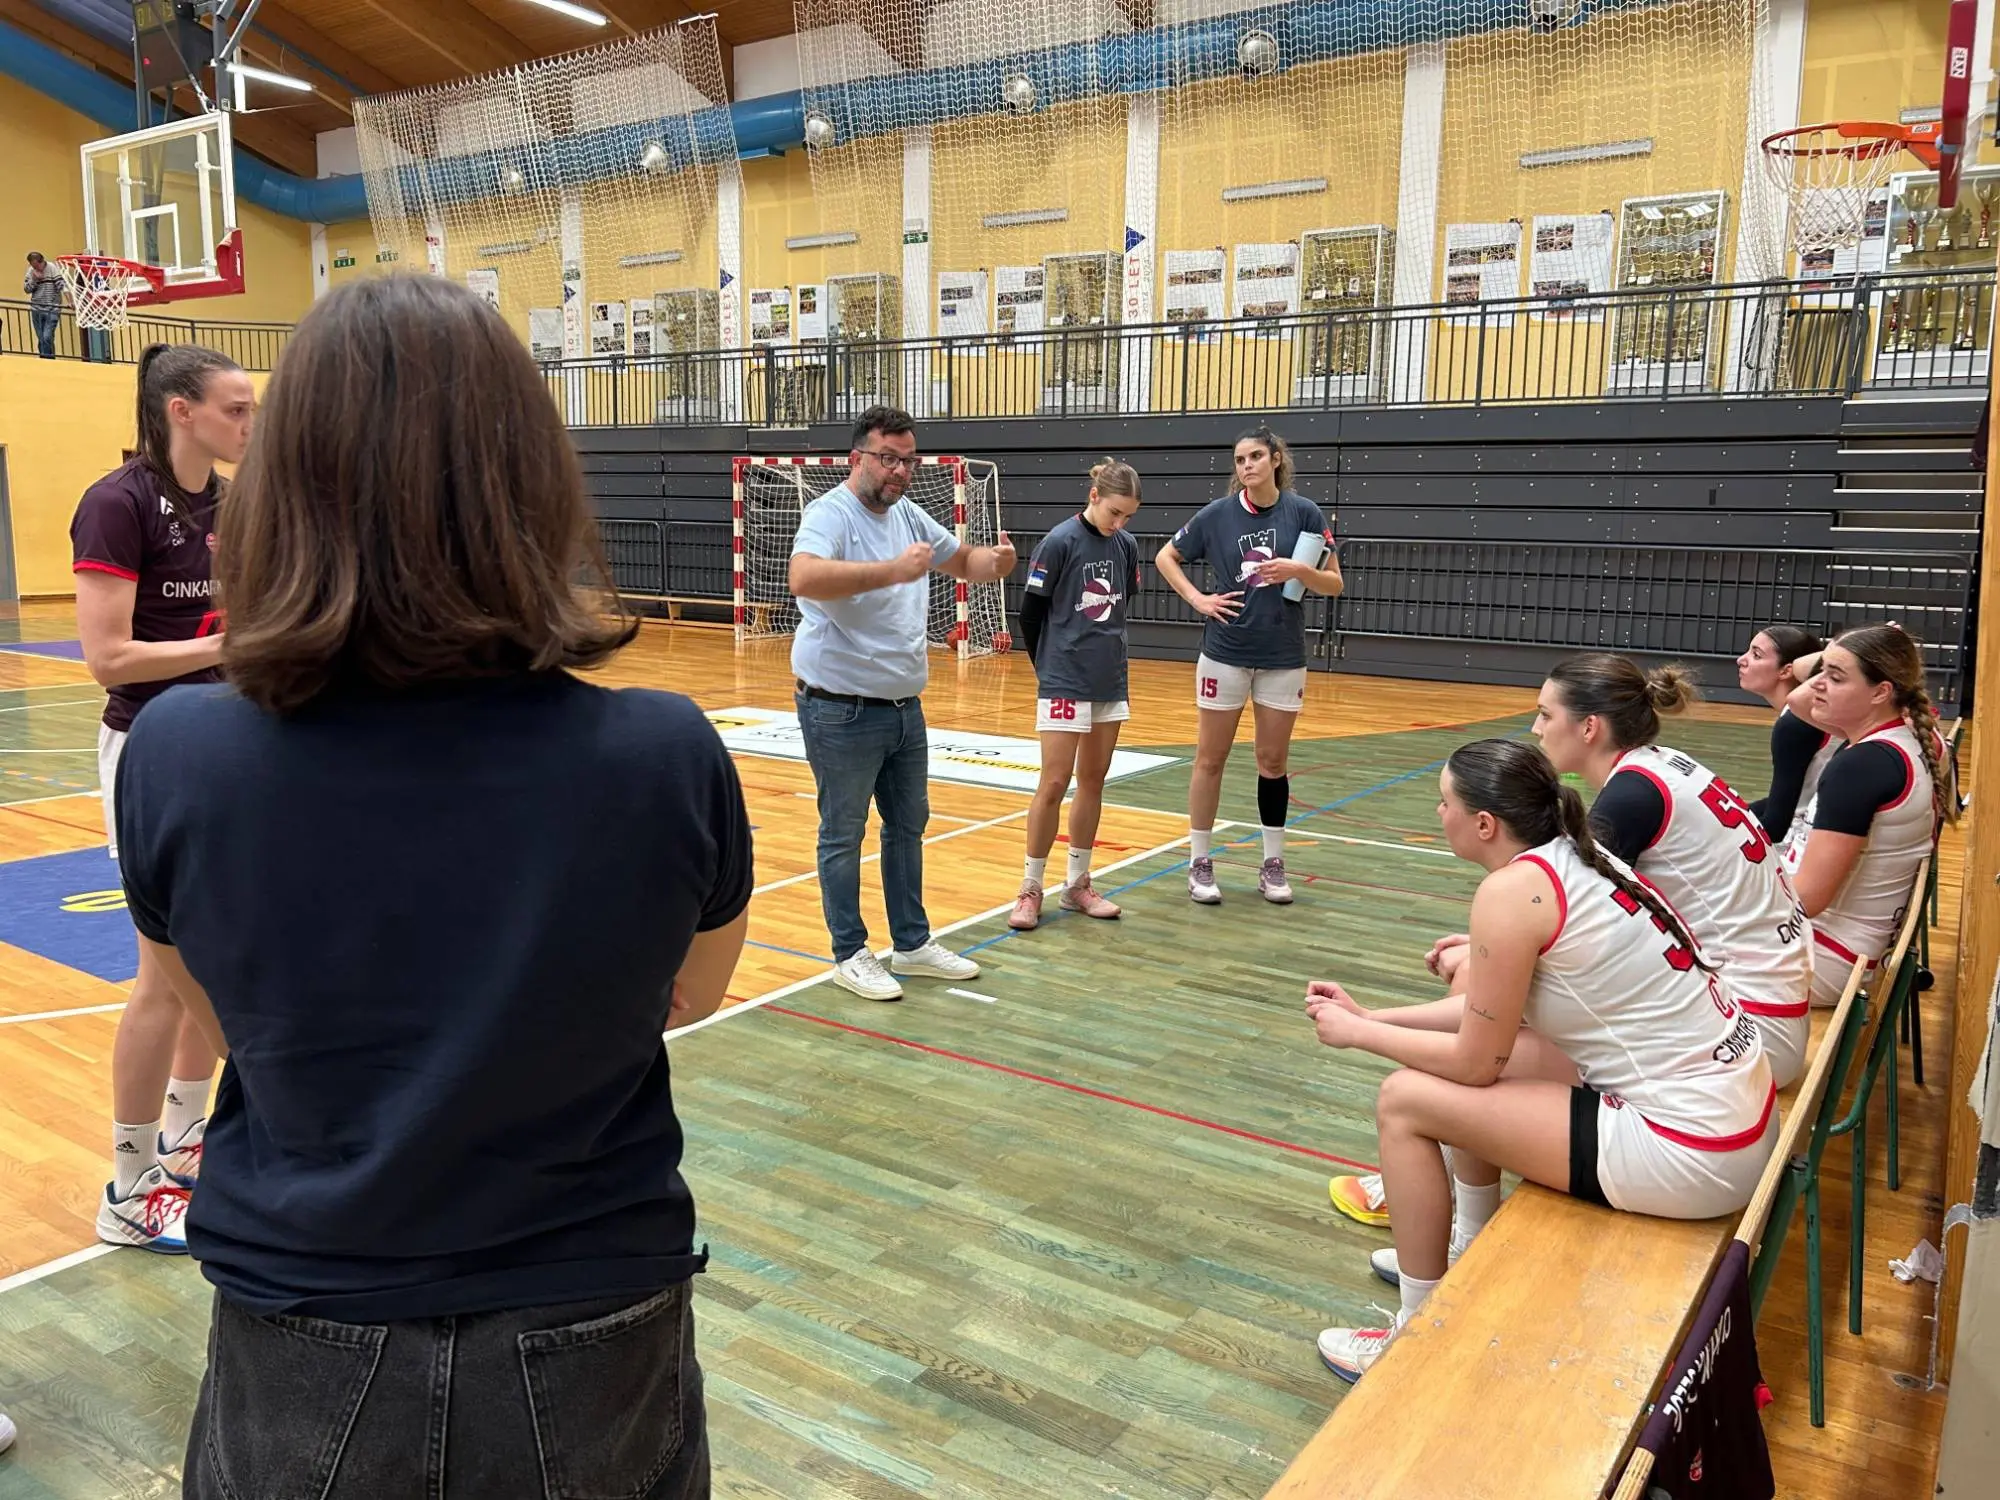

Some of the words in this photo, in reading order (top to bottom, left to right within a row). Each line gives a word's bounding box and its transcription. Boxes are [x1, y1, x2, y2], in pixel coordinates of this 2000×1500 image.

[1128, 256, 1140, 289] LET
[723, 293, 732, 319] LET
[1128, 297, 1139, 318] 30
[567, 307, 575, 331] LET
[723, 328, 732, 345] 20
[1200, 677, 1217, 698] 15
[1050, 697, 1076, 720] 26
